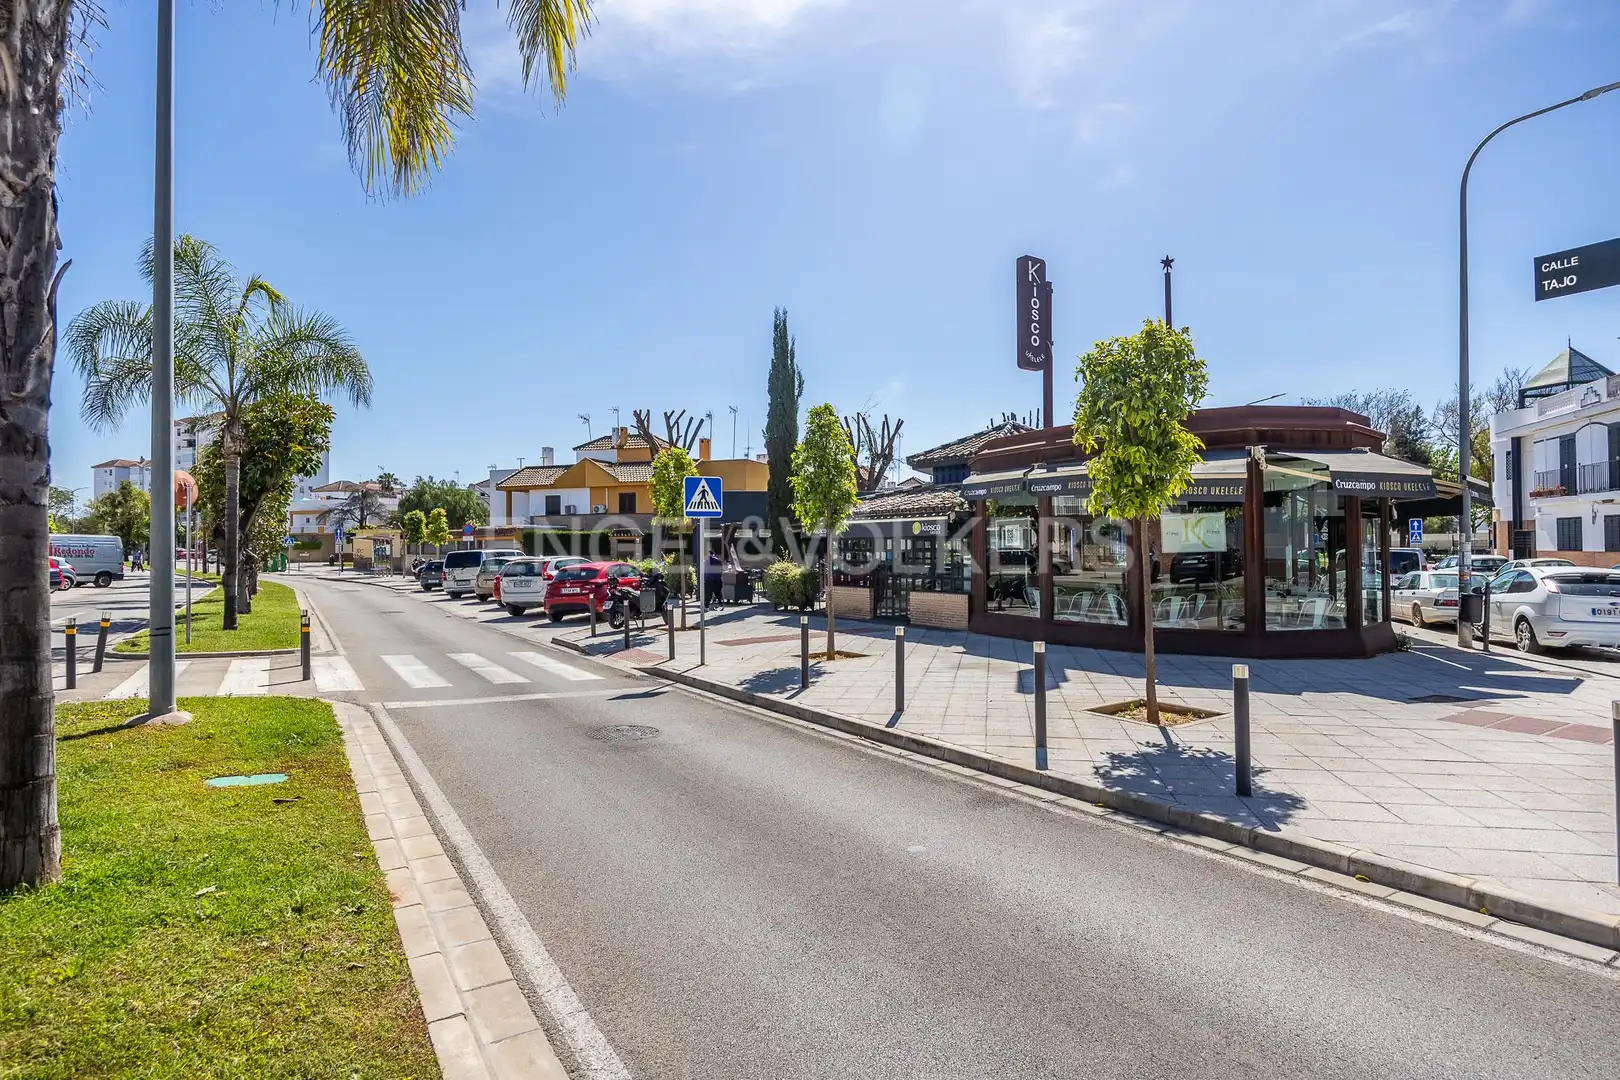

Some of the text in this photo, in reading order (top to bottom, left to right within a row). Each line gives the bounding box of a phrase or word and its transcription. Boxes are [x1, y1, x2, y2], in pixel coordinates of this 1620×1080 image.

[1541, 256, 1579, 272] CALLE
[1541, 275, 1577, 291] TAJO
[1025, 349, 1045, 363] UKELELE
[1031, 483, 1062, 492] Cruzcampo
[1068, 481, 1086, 489] KIOSCO
[1210, 486, 1244, 496] UKELELE
[1335, 479, 1430, 492] Cruzcampo KIOSCO UKELELE
[921, 523, 942, 531] kiosco
[54, 546, 96, 557] Redondo
[1596, 608, 1617, 616] 0191
